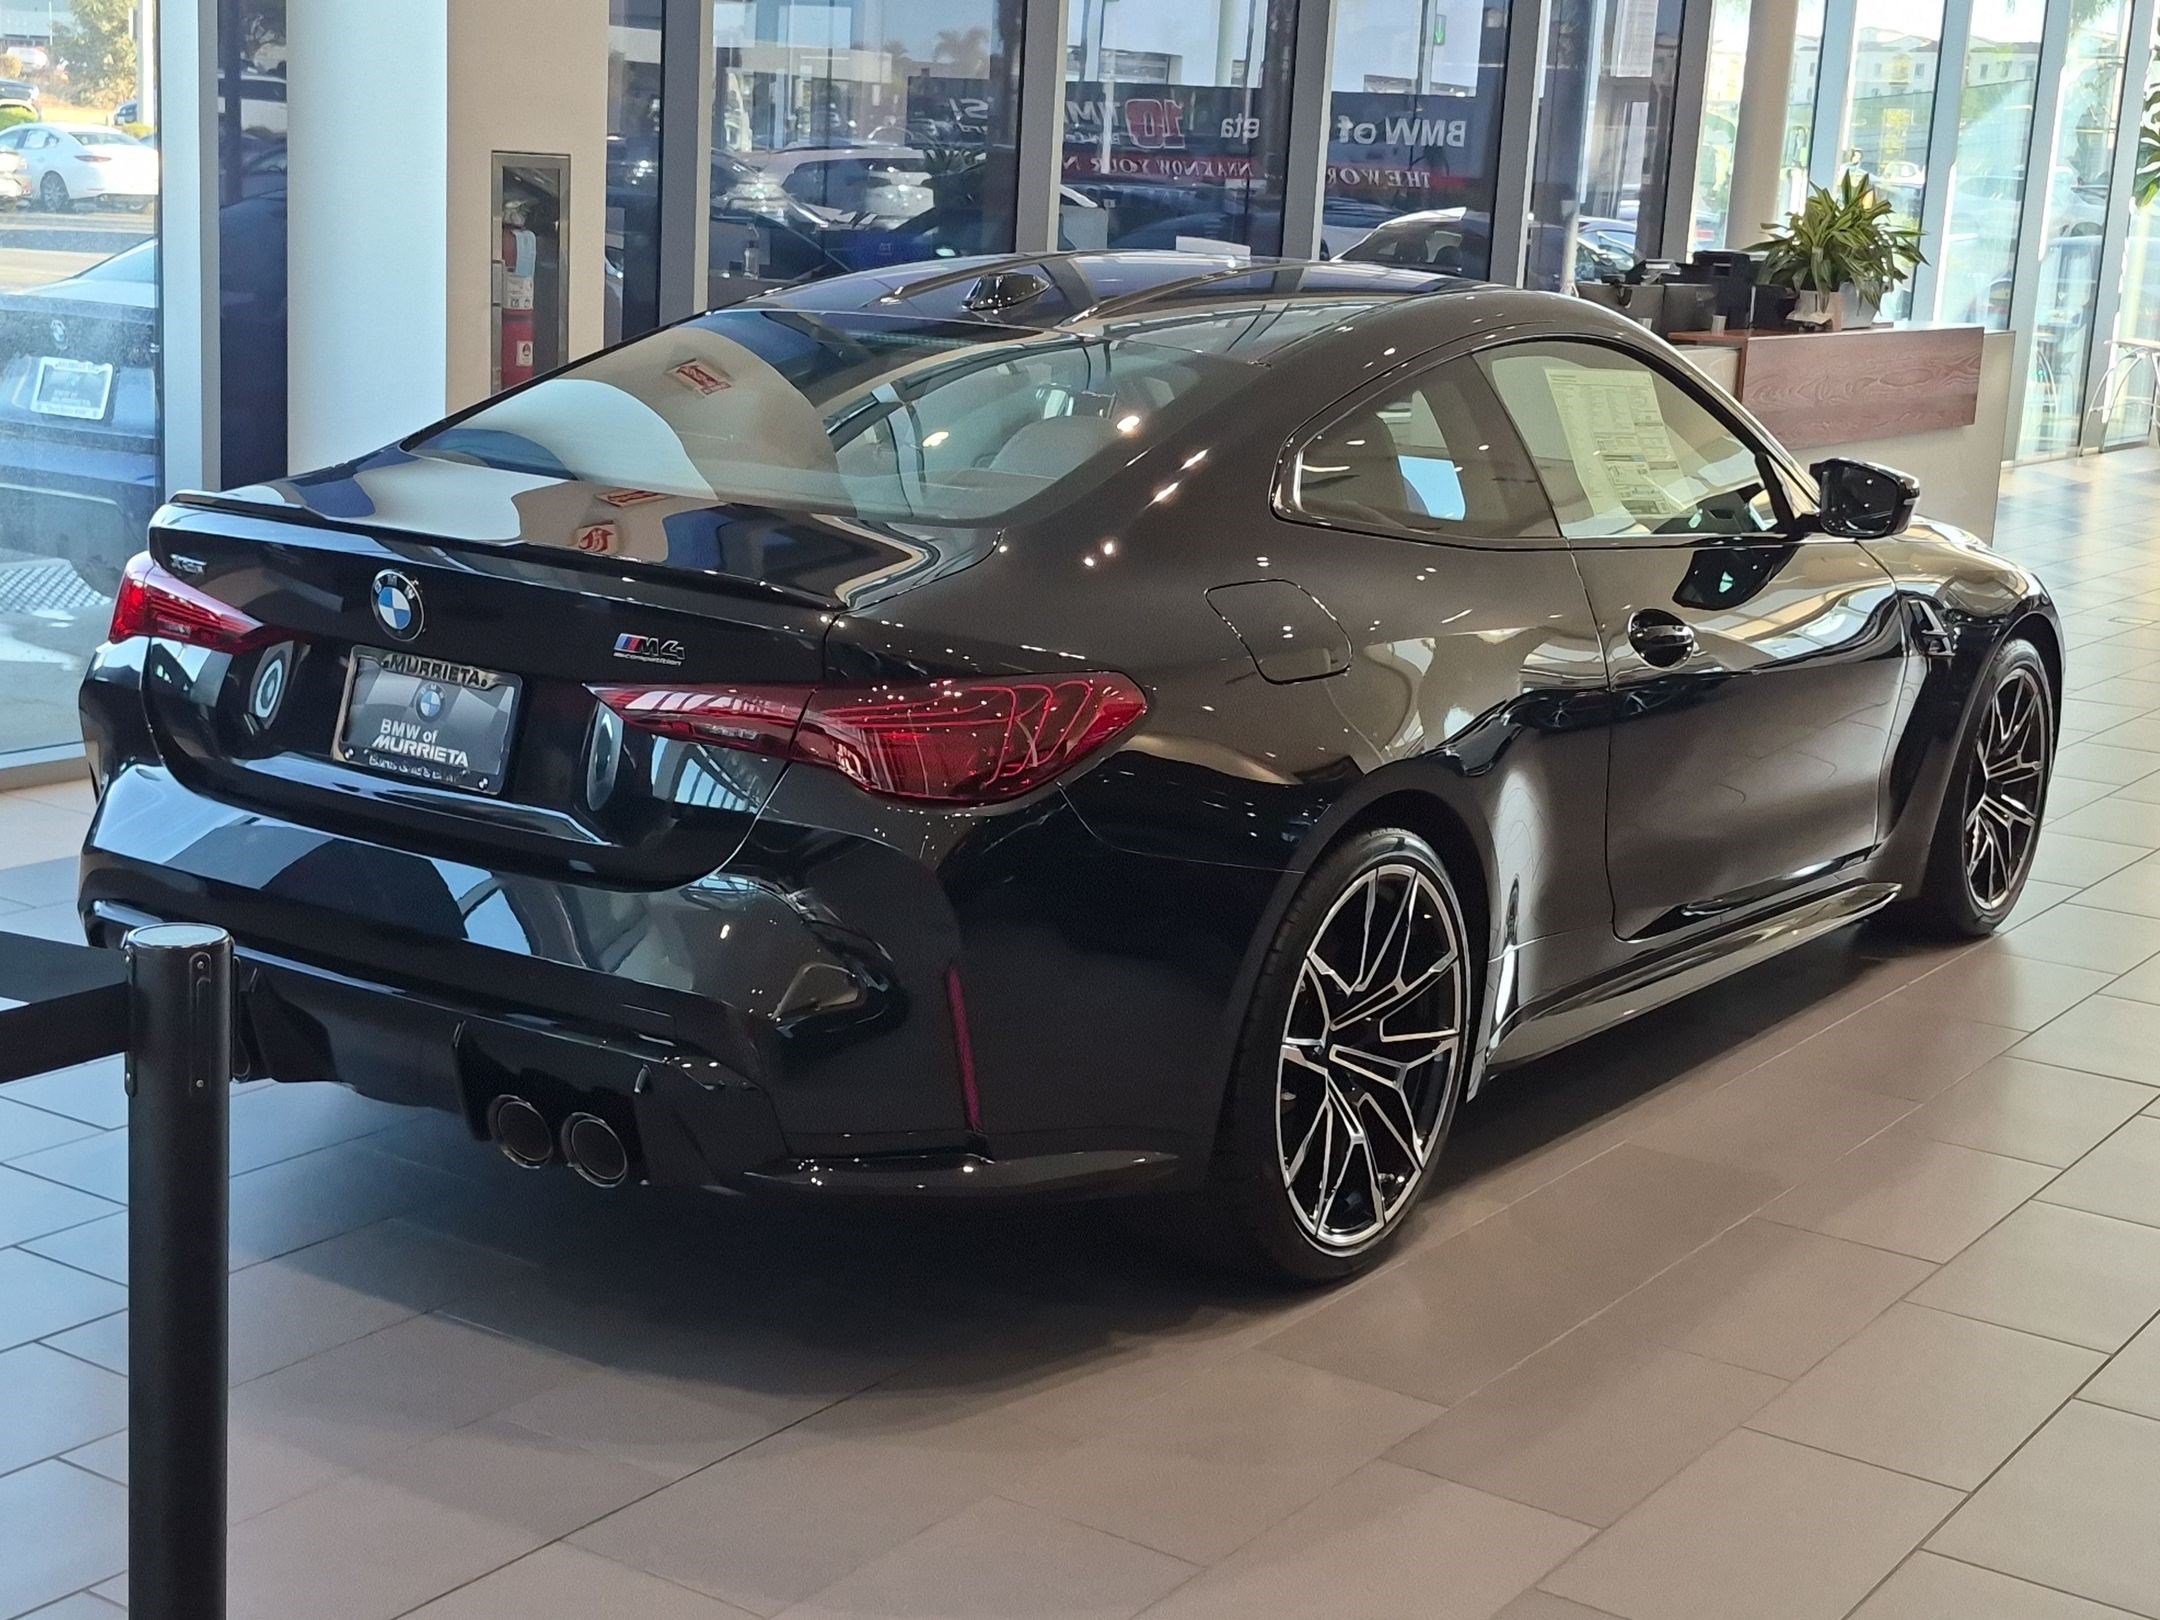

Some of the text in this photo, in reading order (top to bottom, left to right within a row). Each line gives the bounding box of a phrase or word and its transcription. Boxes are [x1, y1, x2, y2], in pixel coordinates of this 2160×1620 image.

[637, 634, 686, 660] M4
[391, 653, 482, 686] MURRIETA
[380, 718, 439, 744] BMW of
[372, 734, 469, 768] MURRIETA
